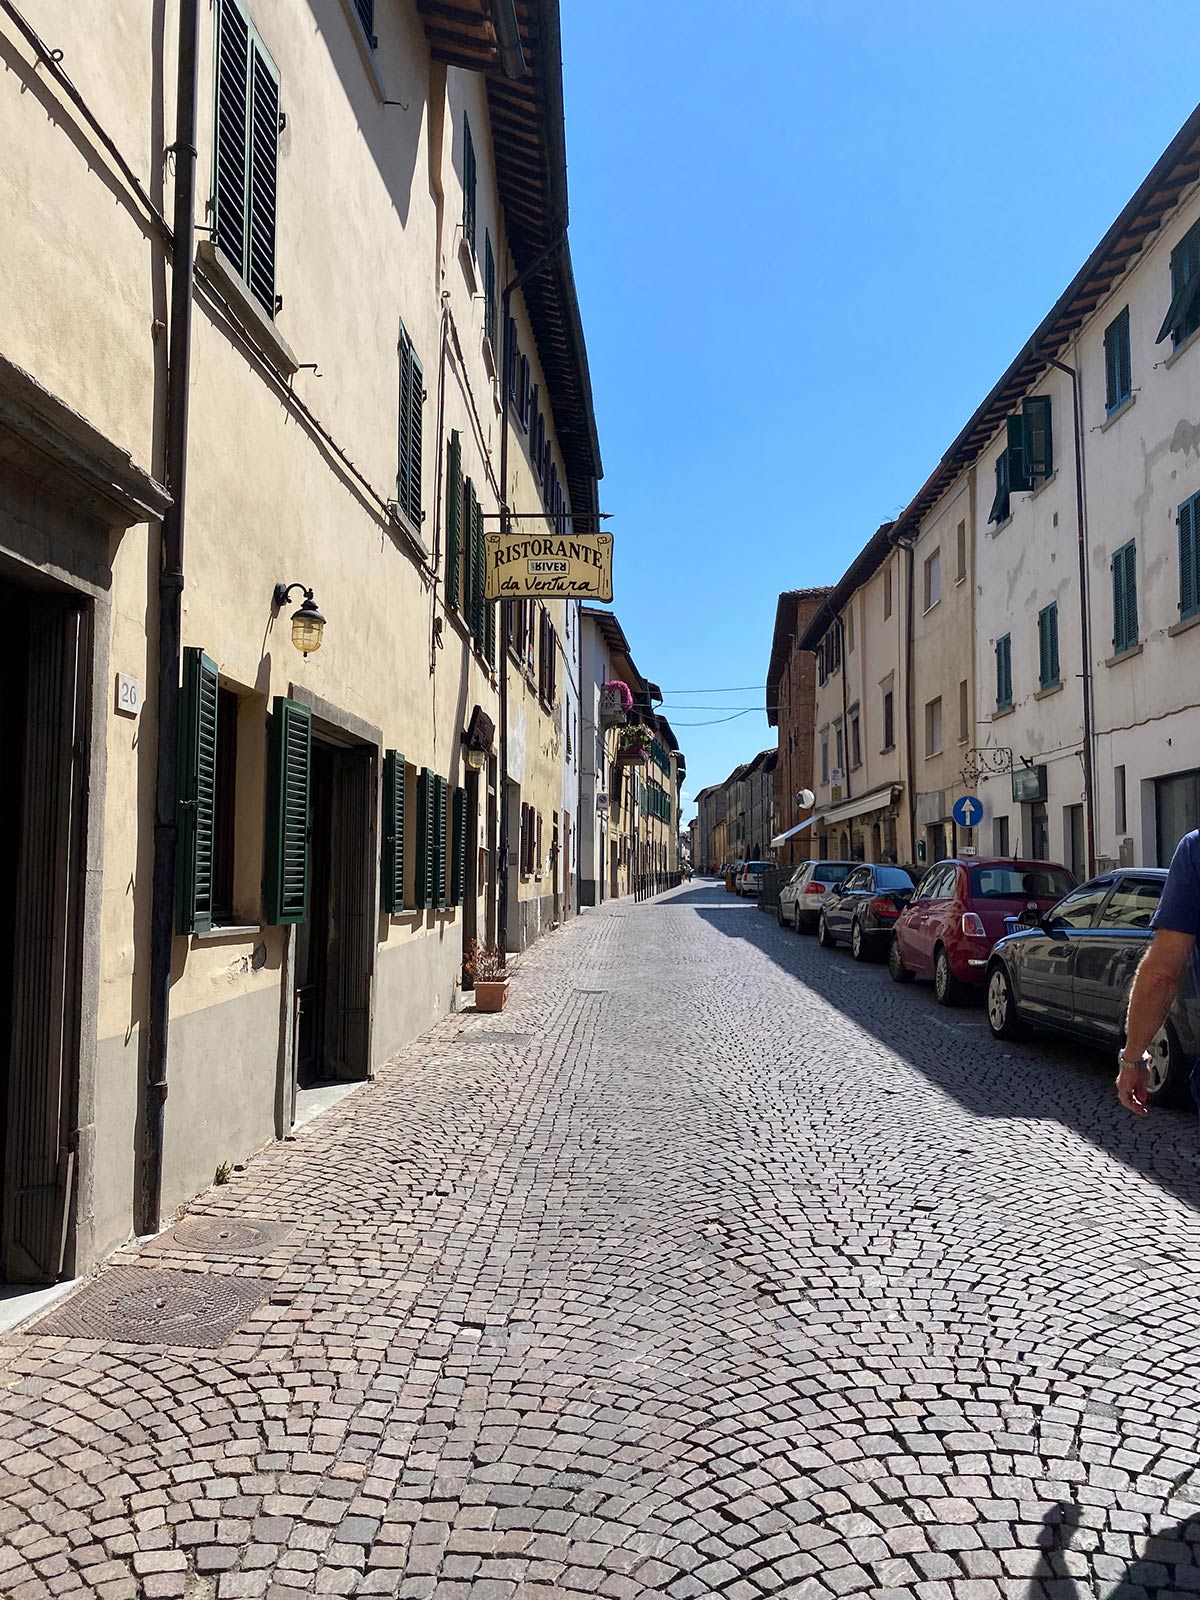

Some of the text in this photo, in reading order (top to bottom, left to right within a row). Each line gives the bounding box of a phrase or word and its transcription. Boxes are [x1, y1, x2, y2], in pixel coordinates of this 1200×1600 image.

[494, 539, 602, 569] RISTORANTE
[535, 562, 567, 571] RIVER
[501, 576, 599, 591] da Ventura
[121, 682, 137, 705] 26
